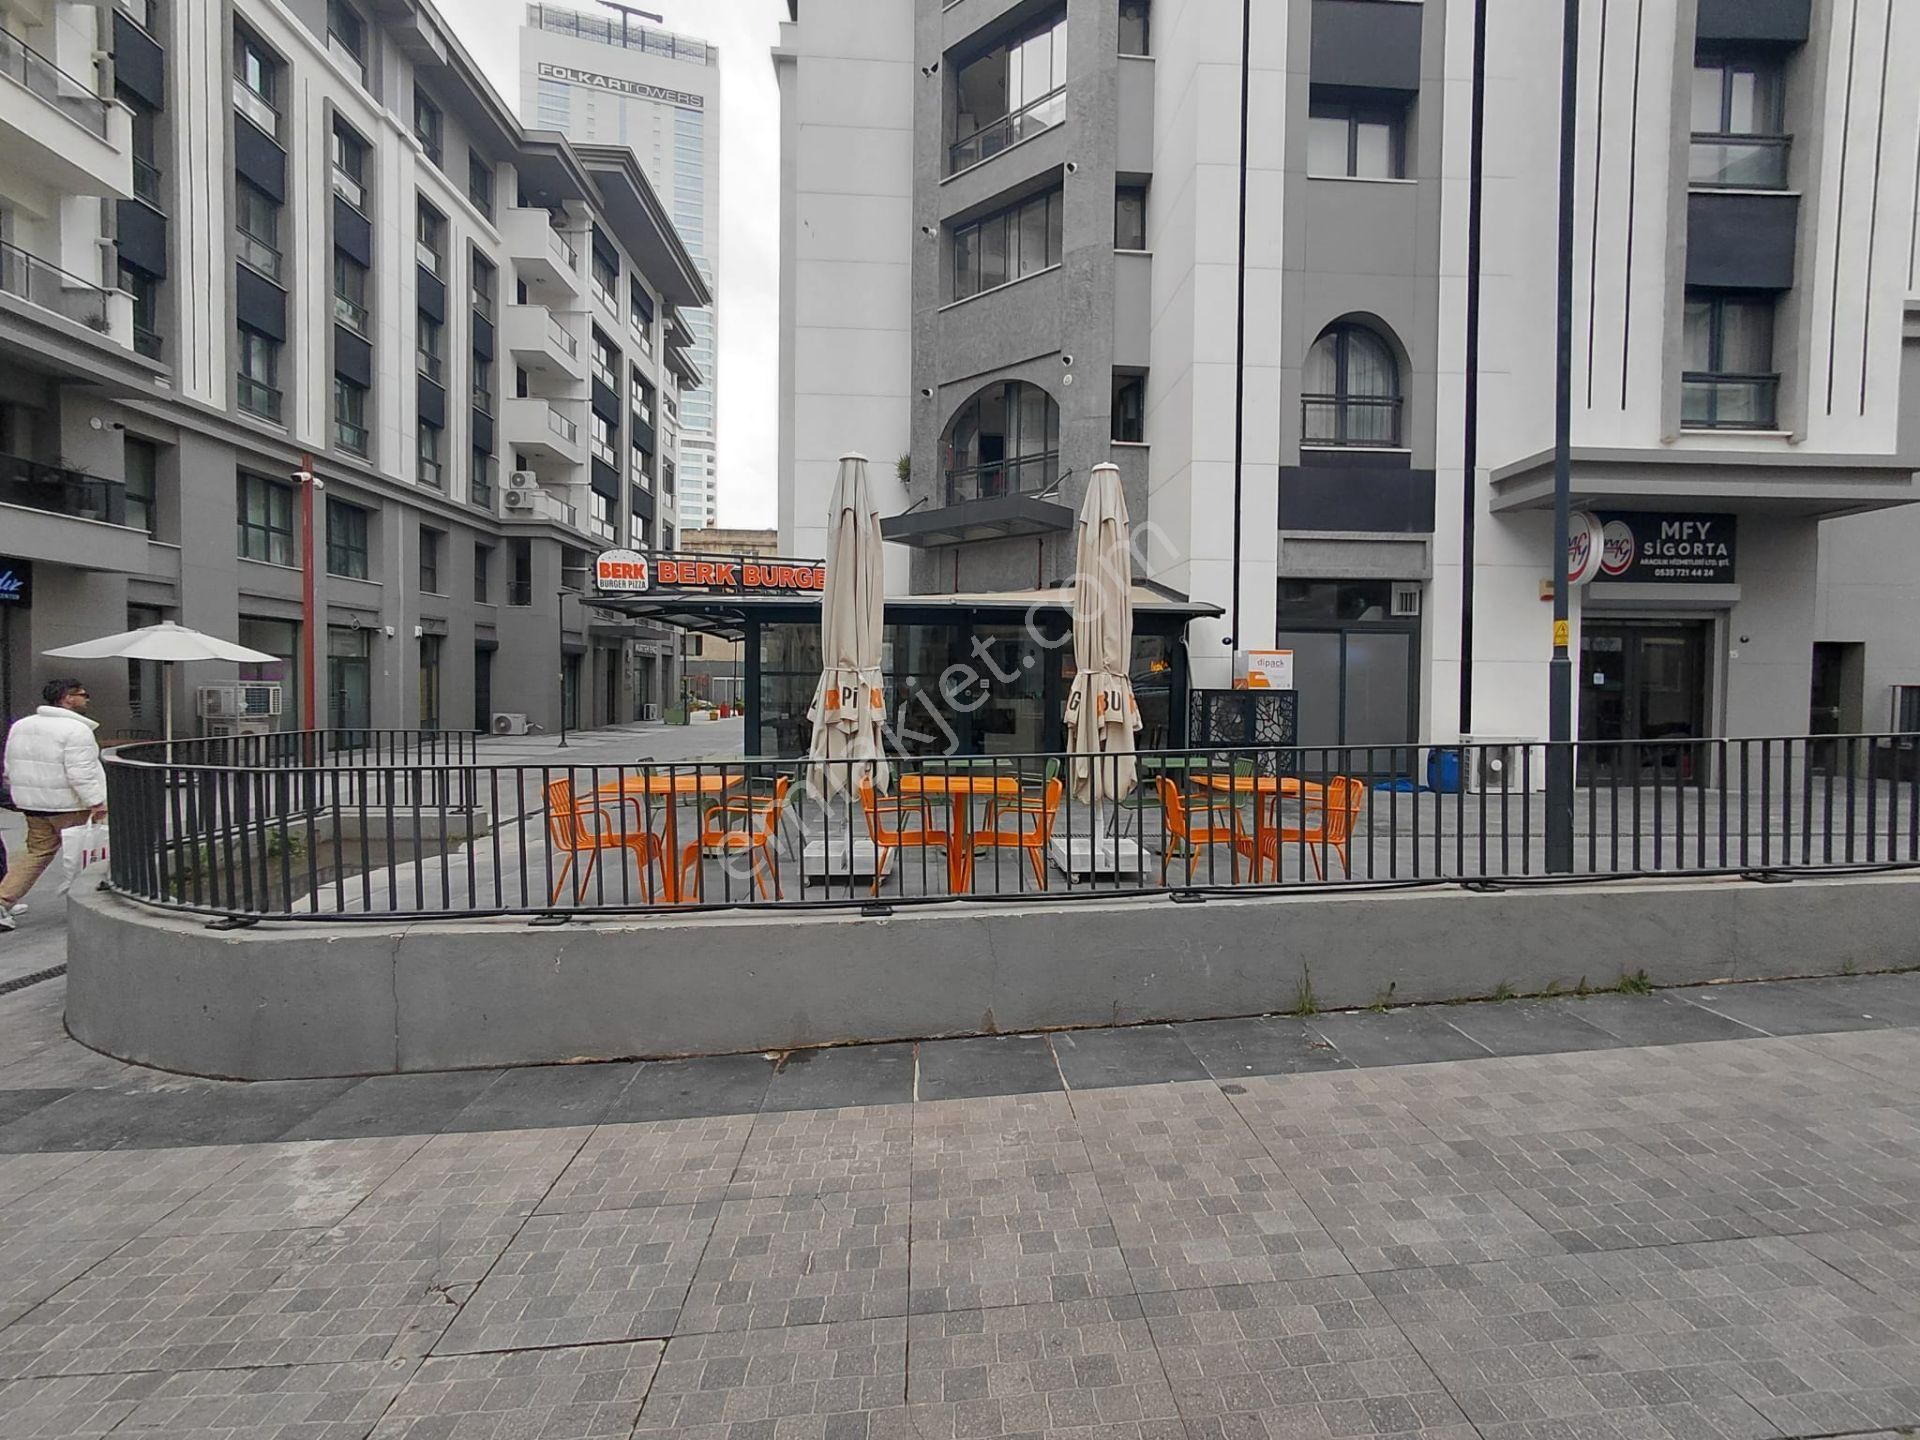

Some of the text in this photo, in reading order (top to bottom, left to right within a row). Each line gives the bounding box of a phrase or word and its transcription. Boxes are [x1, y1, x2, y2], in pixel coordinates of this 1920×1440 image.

[1661, 521, 1711, 540] MFY
[1644, 538, 1728, 556] SİGORTA
[599, 562, 646, 579] BERK
[657, 560, 737, 586] BERK
[1676, 568, 1690, 577] 721
[1691, 568, 1702, 577] 44
[1703, 569, 1714, 577] 24
[600, 579, 627, 588] BURGER
